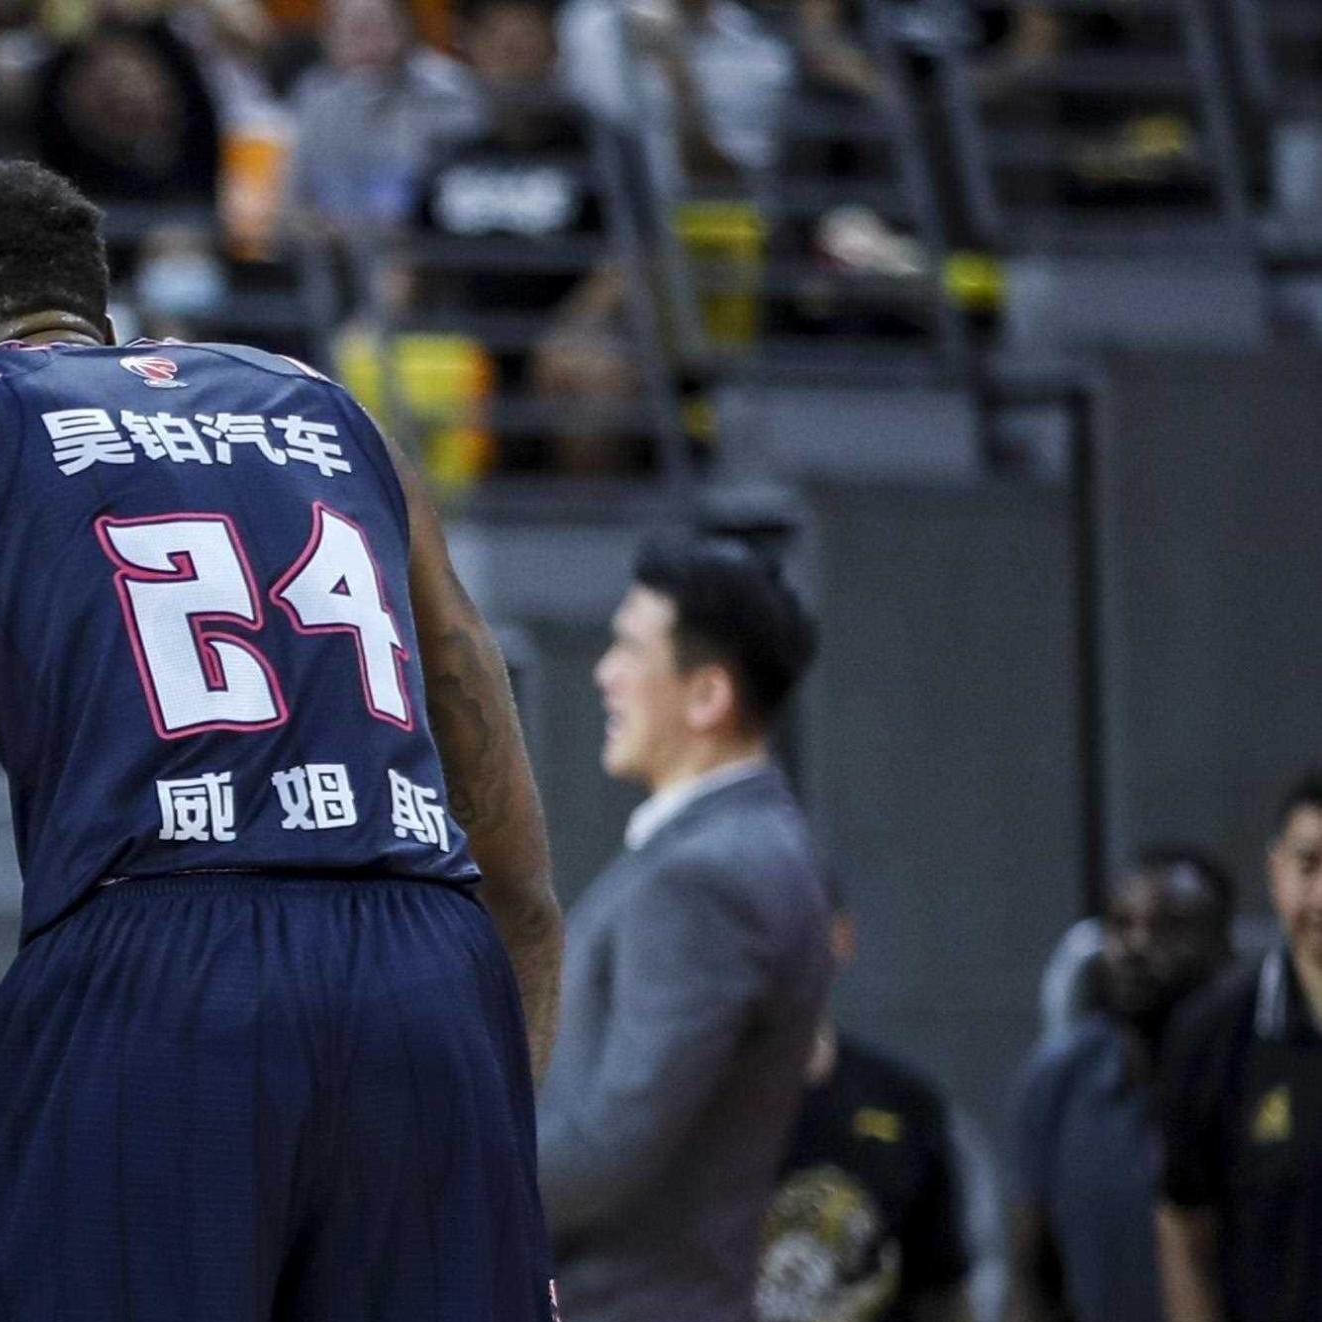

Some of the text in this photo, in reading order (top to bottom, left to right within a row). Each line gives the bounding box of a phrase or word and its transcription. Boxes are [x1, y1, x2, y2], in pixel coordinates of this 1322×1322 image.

[41, 408, 352, 477] 昊铂汽车
[93, 500, 414, 740] 24
[156, 762, 451, 855] 威姆斯
